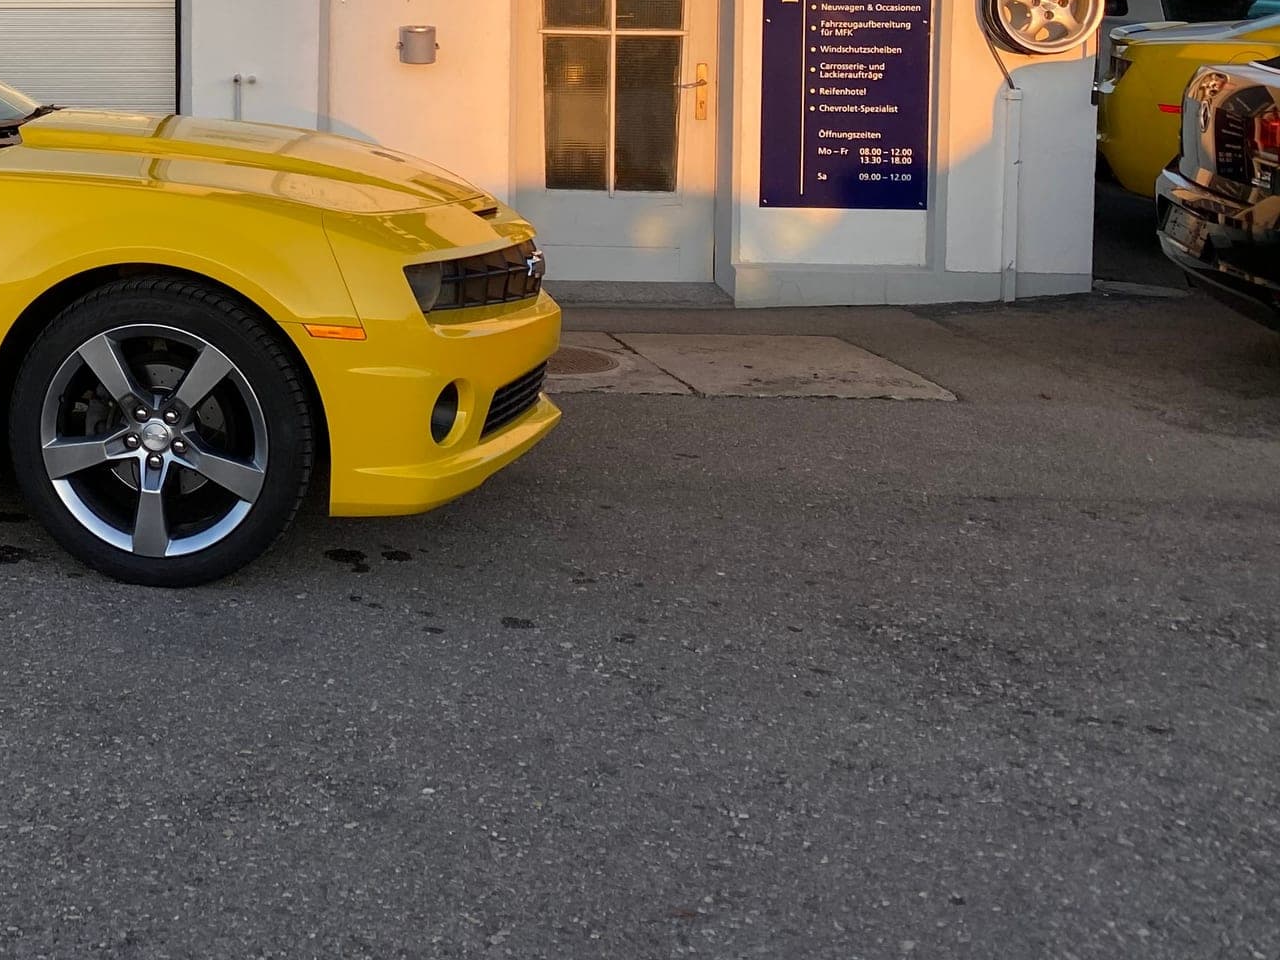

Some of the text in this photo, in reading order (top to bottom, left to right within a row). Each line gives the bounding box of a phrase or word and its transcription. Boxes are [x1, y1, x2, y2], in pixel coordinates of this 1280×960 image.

[821, 3, 921, 13] Neuwagen & Occasionen
[821, 21, 911, 30] Fahrzeugaufbereitung
[821, 29, 853, 37] für MFK
[820, 45, 902, 54] Windschutzscheiben
[820, 62, 885, 71] Carrosserie- und
[819, 70, 883, 80] Lackieraufträge
[819, 87, 867, 96] Reifenhotel
[819, 104, 898, 114] Chevrolet-Spezialist
[818, 130, 881, 140] Öffnungszeiten
[818, 147, 832, 155] Mo
[840, 147, 849, 155] Fr
[859, 148, 882, 156] 08.00
[891, 148, 912, 156] 12.00
[860, 156, 881, 164] 13.30
[891, 157, 912, 165] 18.00
[817, 172, 828, 181] Sa
[858, 173, 881, 182] 09.00
[890, 174, 912, 182] 12.00
